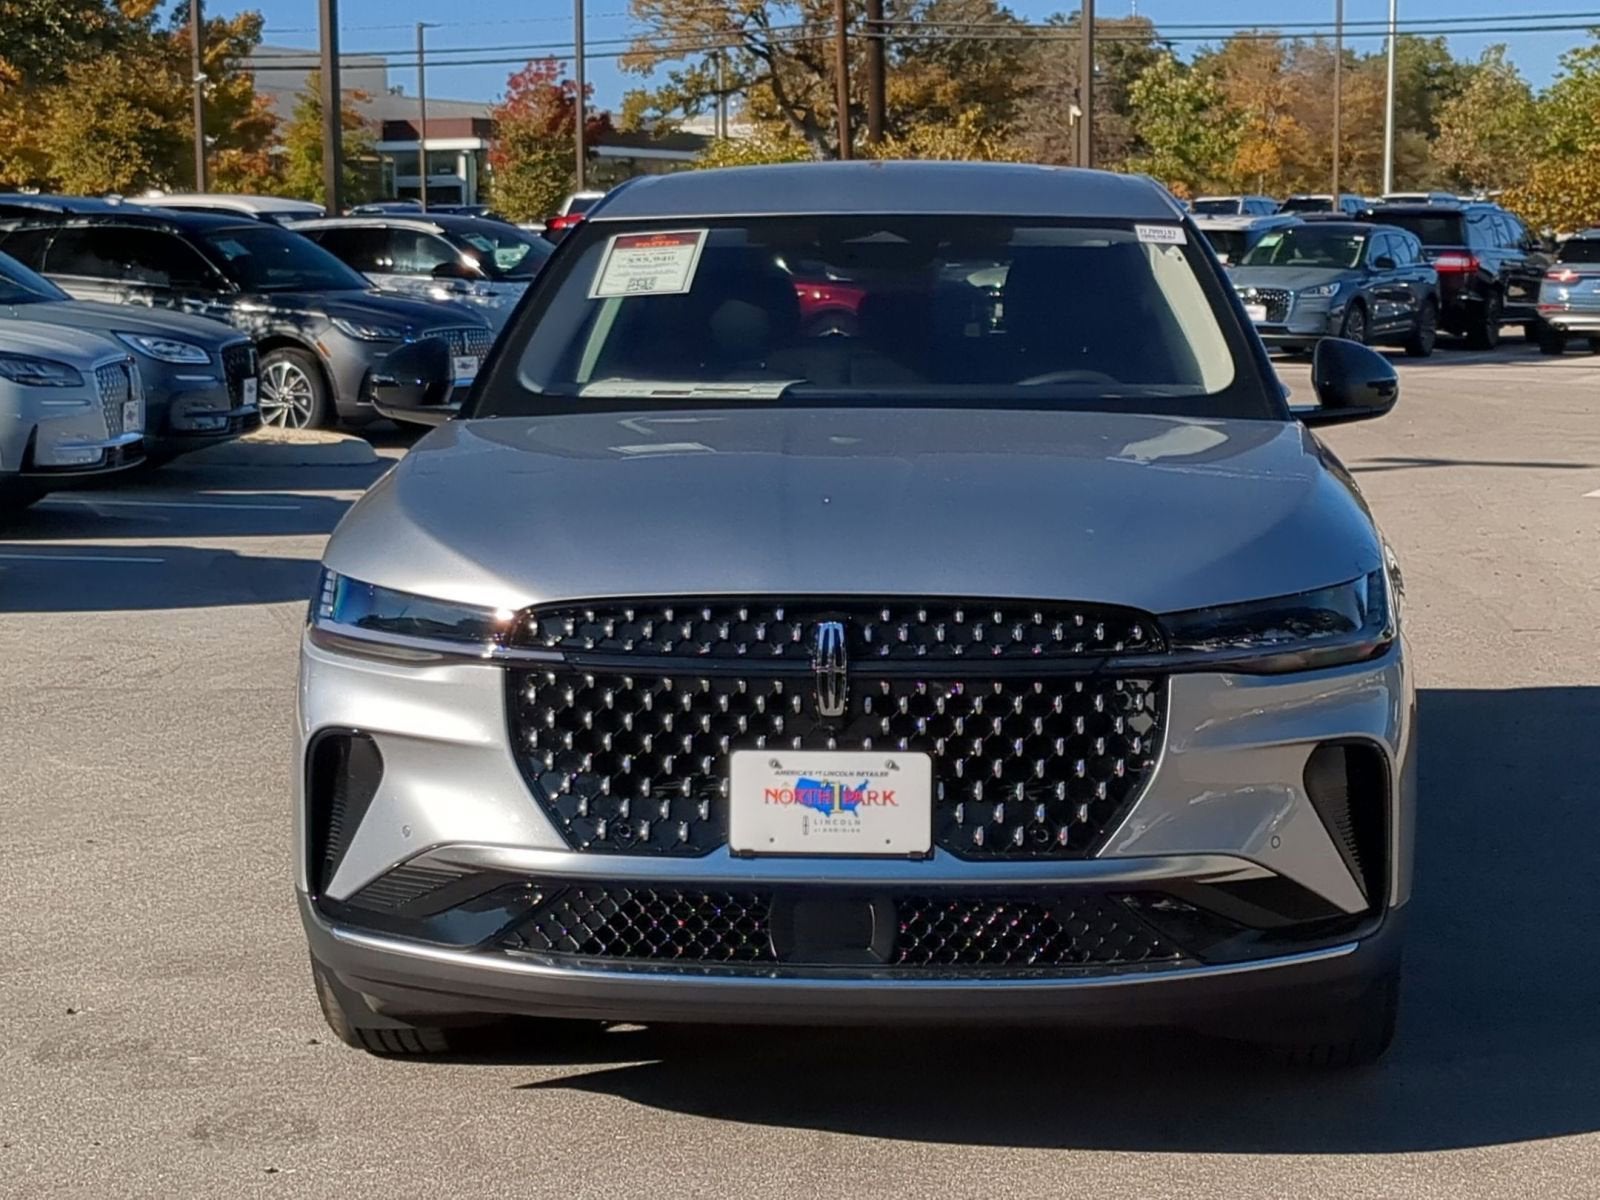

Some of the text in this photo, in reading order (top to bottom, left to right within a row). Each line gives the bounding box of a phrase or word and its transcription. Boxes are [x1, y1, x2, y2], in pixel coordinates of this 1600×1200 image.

[764, 787, 832, 806] NORTH
[844, 789, 900, 807] PARK
[813, 818, 861, 826] LINCOLN
